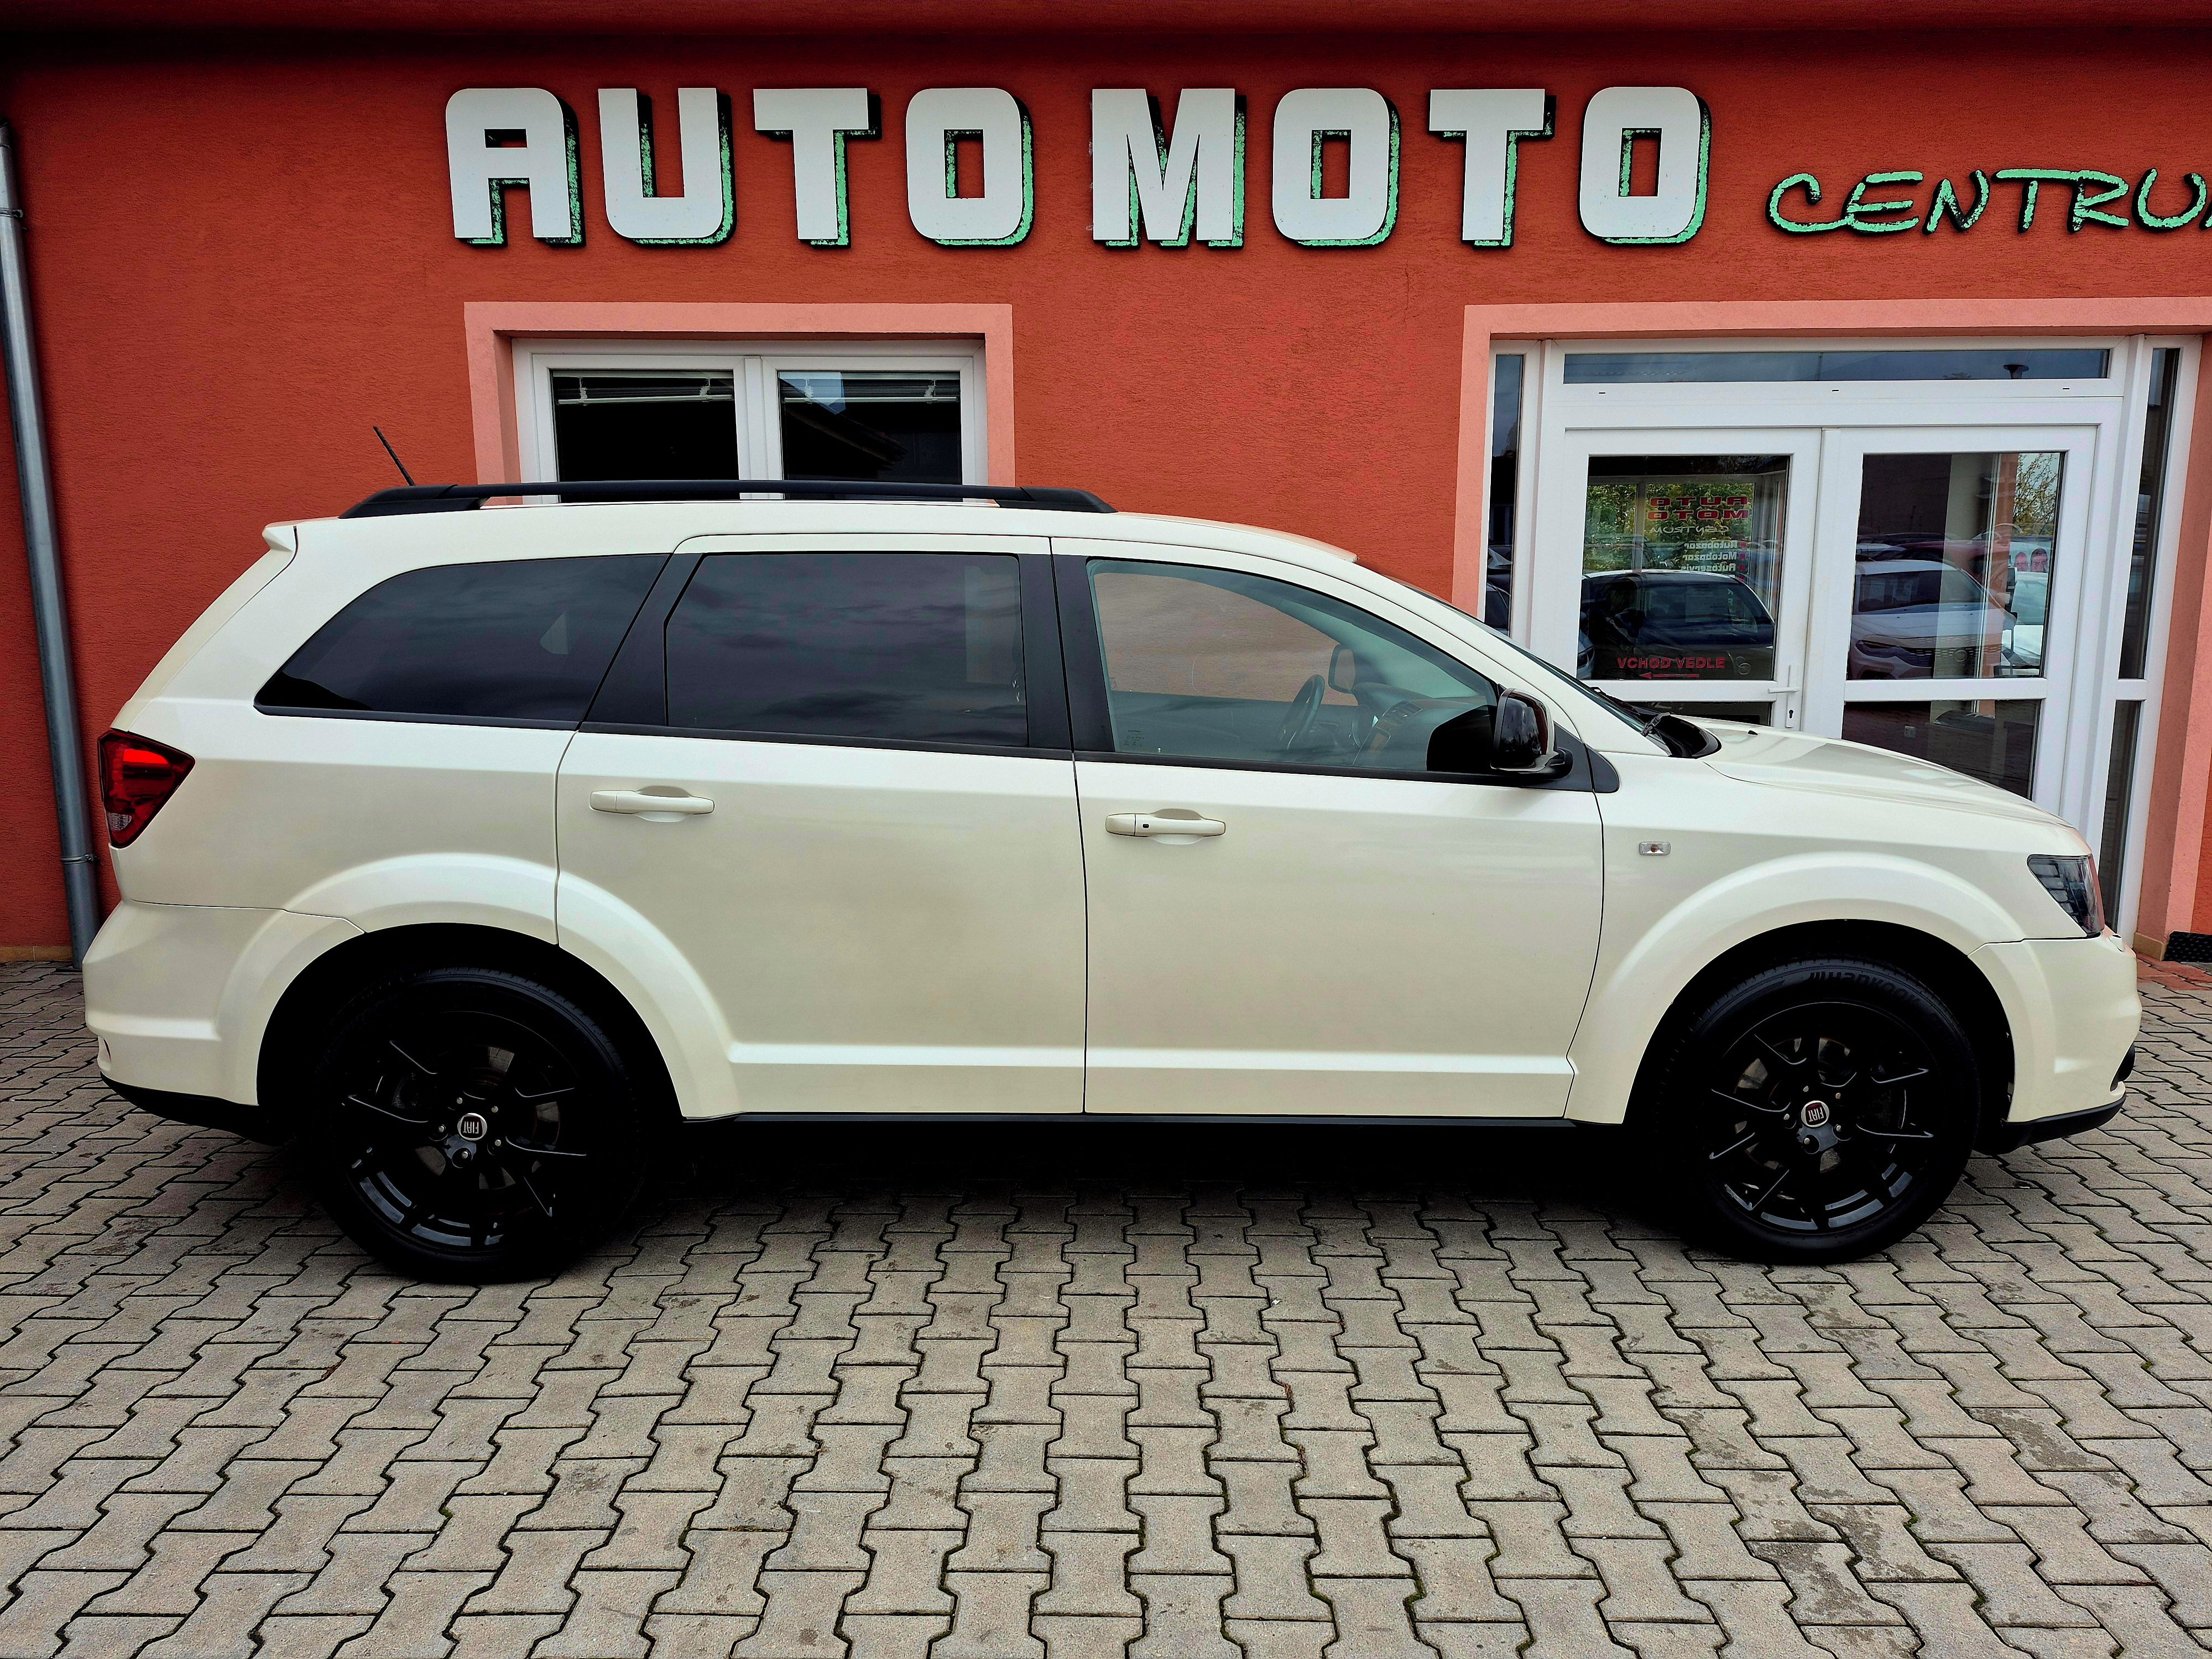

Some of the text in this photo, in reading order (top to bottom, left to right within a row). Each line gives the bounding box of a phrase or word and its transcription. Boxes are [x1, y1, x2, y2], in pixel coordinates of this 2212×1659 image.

[446, 87, 2212, 248] AUTO MOTO CENTRU
[1617, 657, 1725, 669] VCHOD VEDLE
[1807, 1107, 1824, 1122] FIAT
[463, 1121, 479, 1134] FIAT
